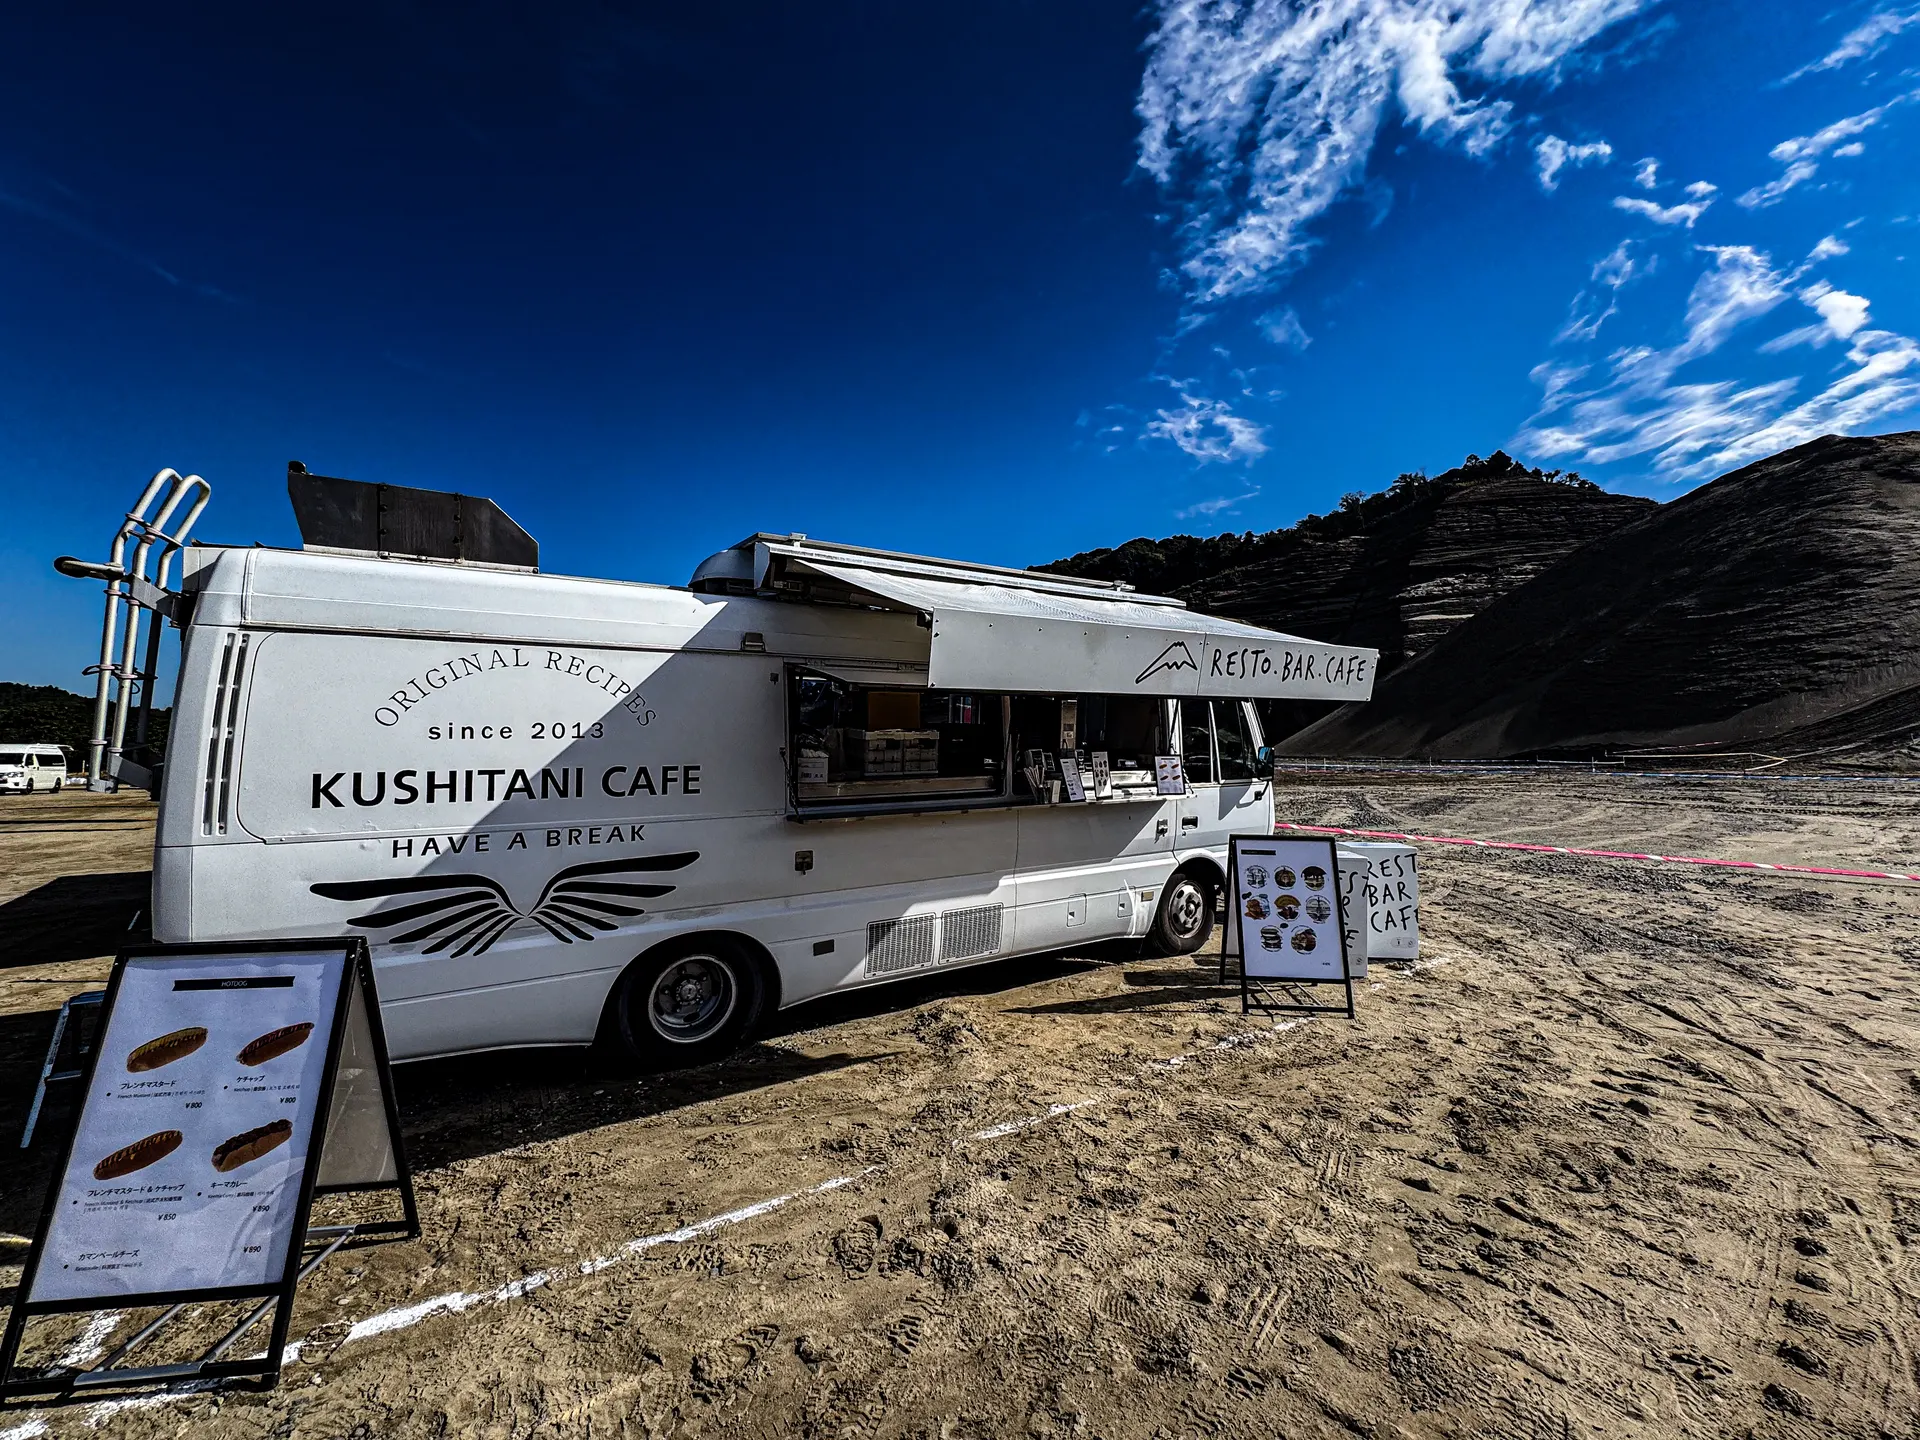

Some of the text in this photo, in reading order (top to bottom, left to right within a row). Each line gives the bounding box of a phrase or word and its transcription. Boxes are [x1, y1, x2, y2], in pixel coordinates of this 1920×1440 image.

[374, 648, 657, 728] ORIGINAL RECIPES
[428, 722, 604, 740] since 2013
[311, 764, 702, 809] KUSHITANI CAFE
[392, 824, 646, 858] HAVE A BREAK
[1366, 881, 1413, 908] BAR
[221, 980, 248, 988] HOTDOG
[120, 1080, 177, 1090] フレンチマスタード
[236, 1075, 266, 1083] ケチャップ
[87, 1187, 145, 1197] フレンチマスタード
[155, 1183, 186, 1192] ケチャップ
[210, 1181, 248, 1189] キーマカレー
[78, 1249, 140, 1261] カマンベールチーズ
